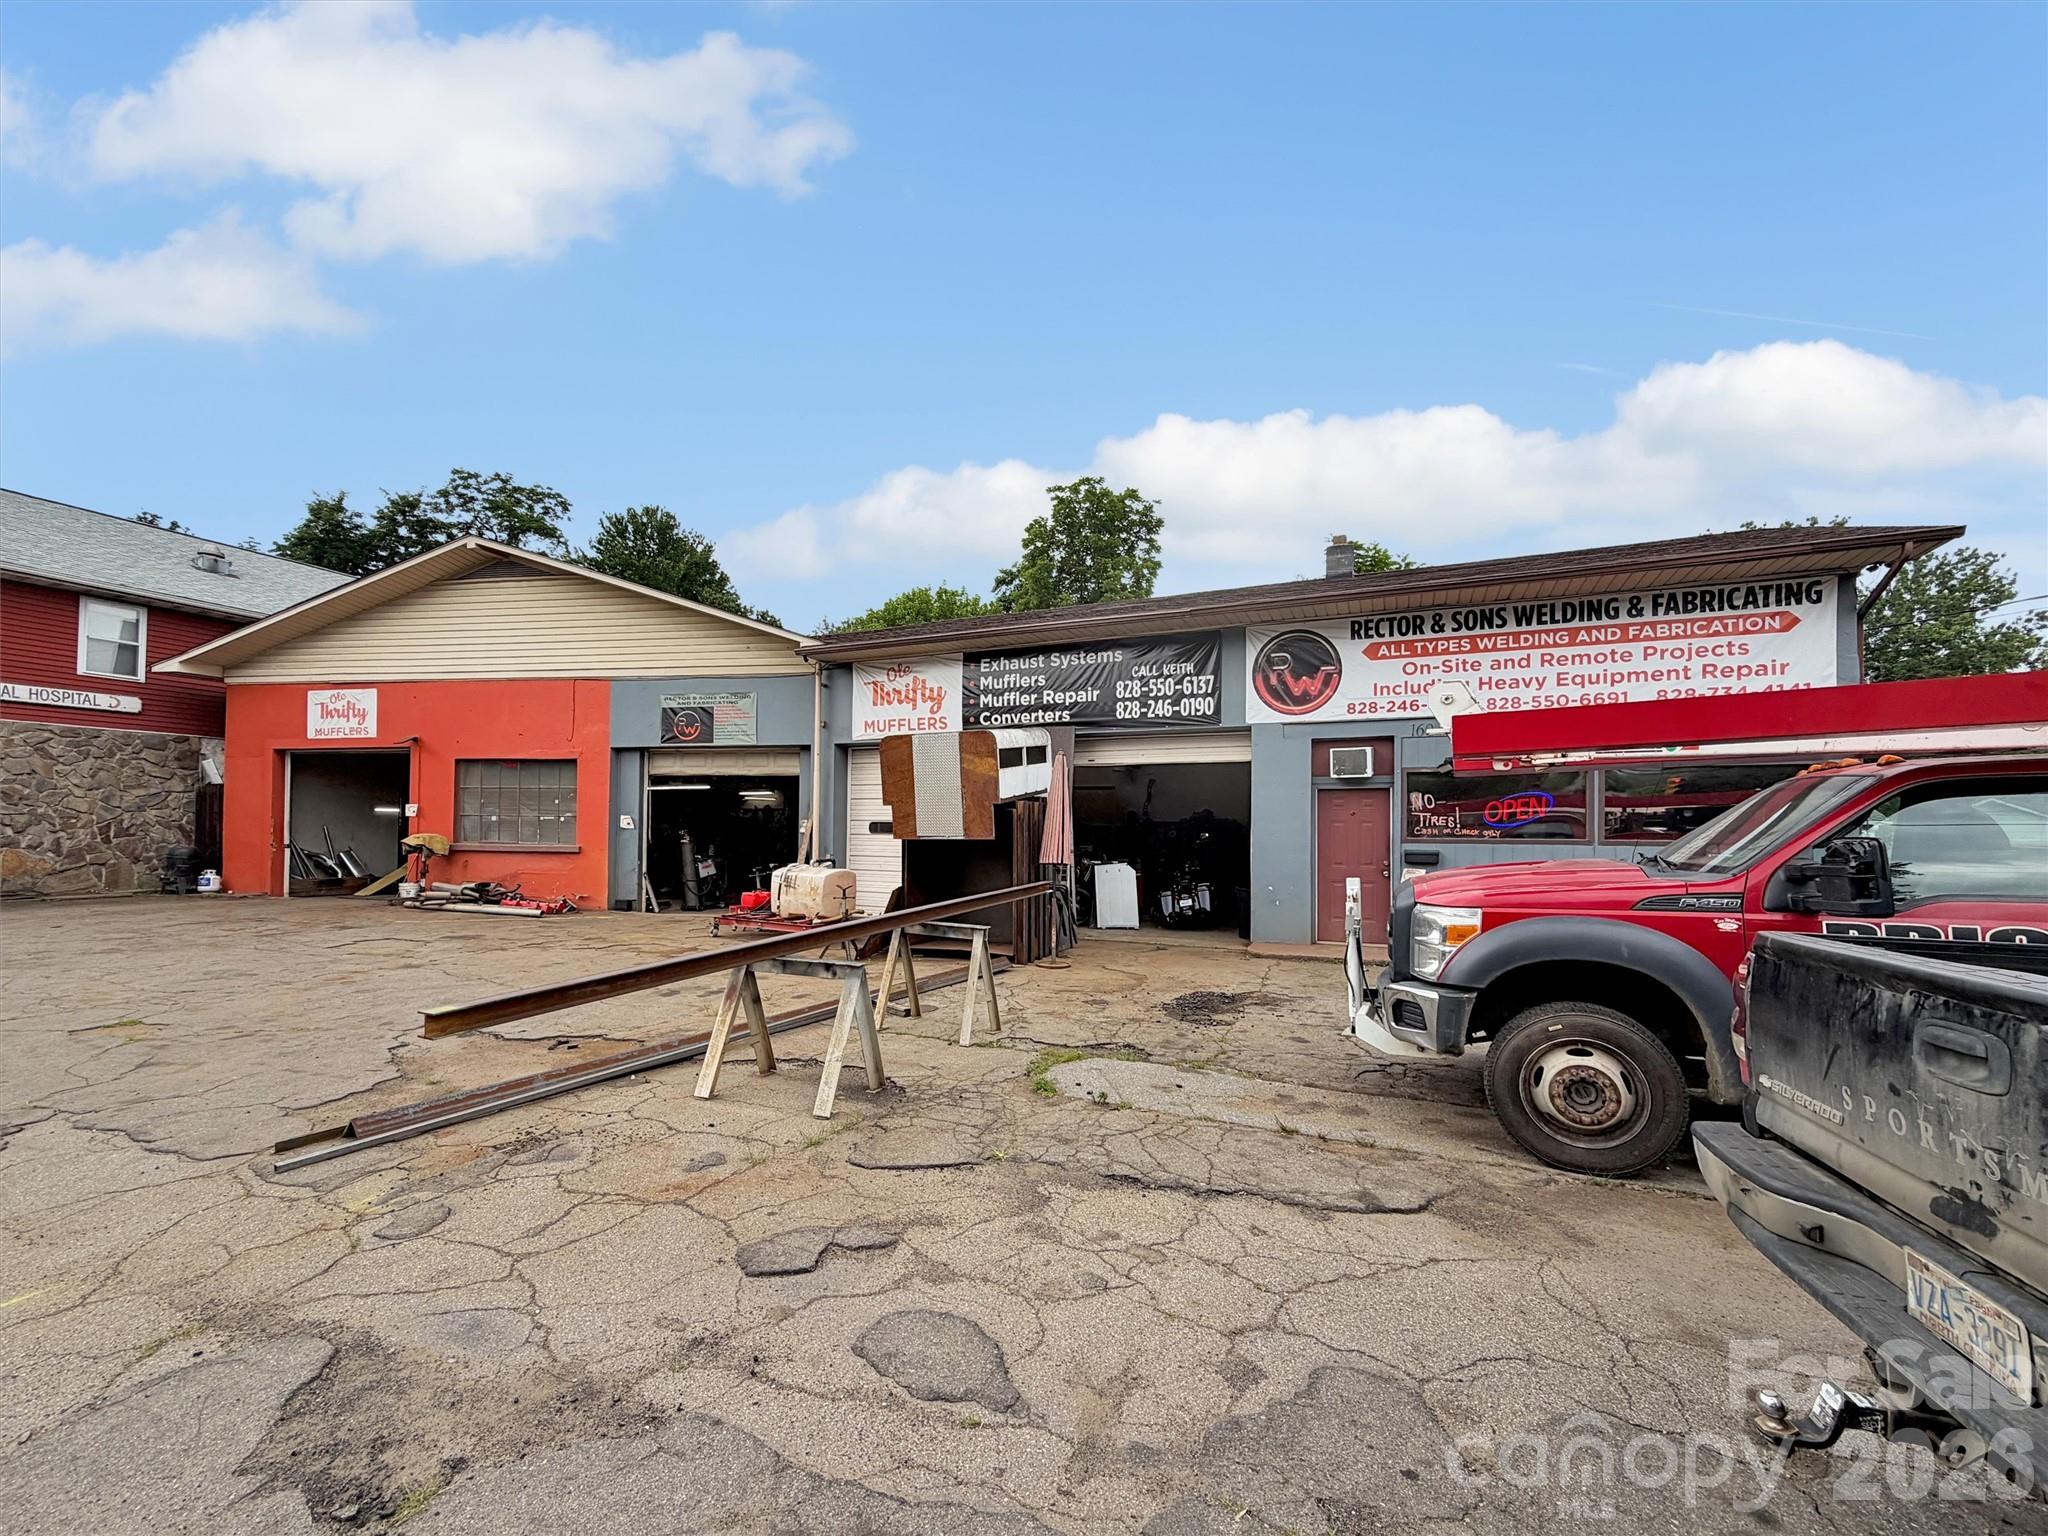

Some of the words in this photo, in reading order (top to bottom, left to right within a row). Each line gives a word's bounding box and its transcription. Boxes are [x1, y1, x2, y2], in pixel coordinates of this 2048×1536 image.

[1350, 615, 1425, 640] RECTOR
[1430, 612, 1446, 634] &
[1451, 606, 1508, 633] SONS
[1513, 597, 1620, 627] WELDING
[1626, 595, 1645, 618] &
[1652, 580, 1823, 617] FABRICATING
[1377, 645, 1411, 657] ALL
[1414, 638, 1471, 654] TYPES
[1477, 631, 1569, 650] WELDING
[1575, 628, 1622, 643] AND
[1628, 615, 1781, 639] FABRICATION
[980, 653, 1045, 673] Exhaust
[1050, 649, 1123, 669] Systems
[1131, 665, 1159, 678] CALL
[1163, 663, 1195, 676] KEITH
[1402, 658, 1482, 676] On-Site
[1490, 653, 1531, 671] and
[1540, 648, 1633, 668] Remote
[1643, 641, 1750, 662] Projects
[886, 663, 912, 682] Ole
[979, 673, 1046, 691] Mufflers
[1478, 675, 1547, 691] Heavy
[1556, 665, 1692, 689] Equipment
[1701, 659, 1790, 681] Repair
[1, 684, 20, 699] AL
[28, 687, 102, 707] HOSPITAL
[863, 675, 947, 714] Thrifty
[979, 691, 1038, 709] Muffler
[1043, 687, 1101, 706] Repair
[1116, 675, 1215, 699] 828-550-6137
[314, 700, 369, 726] Thrifty
[1116, 697, 1214, 719] 828-246-0190
[1346, 700, 1428, 715] 828-246-
[1486, 690, 1629, 711] 828-550-6691
[864, 716, 948, 733] MUFFLERS
[979, 709, 1071, 727] Converters
[314, 726, 369, 737] MUFFLERS
[1484, 797, 1547, 822] OPEN
[1771, 1080, 1844, 1125] SILVERADO
